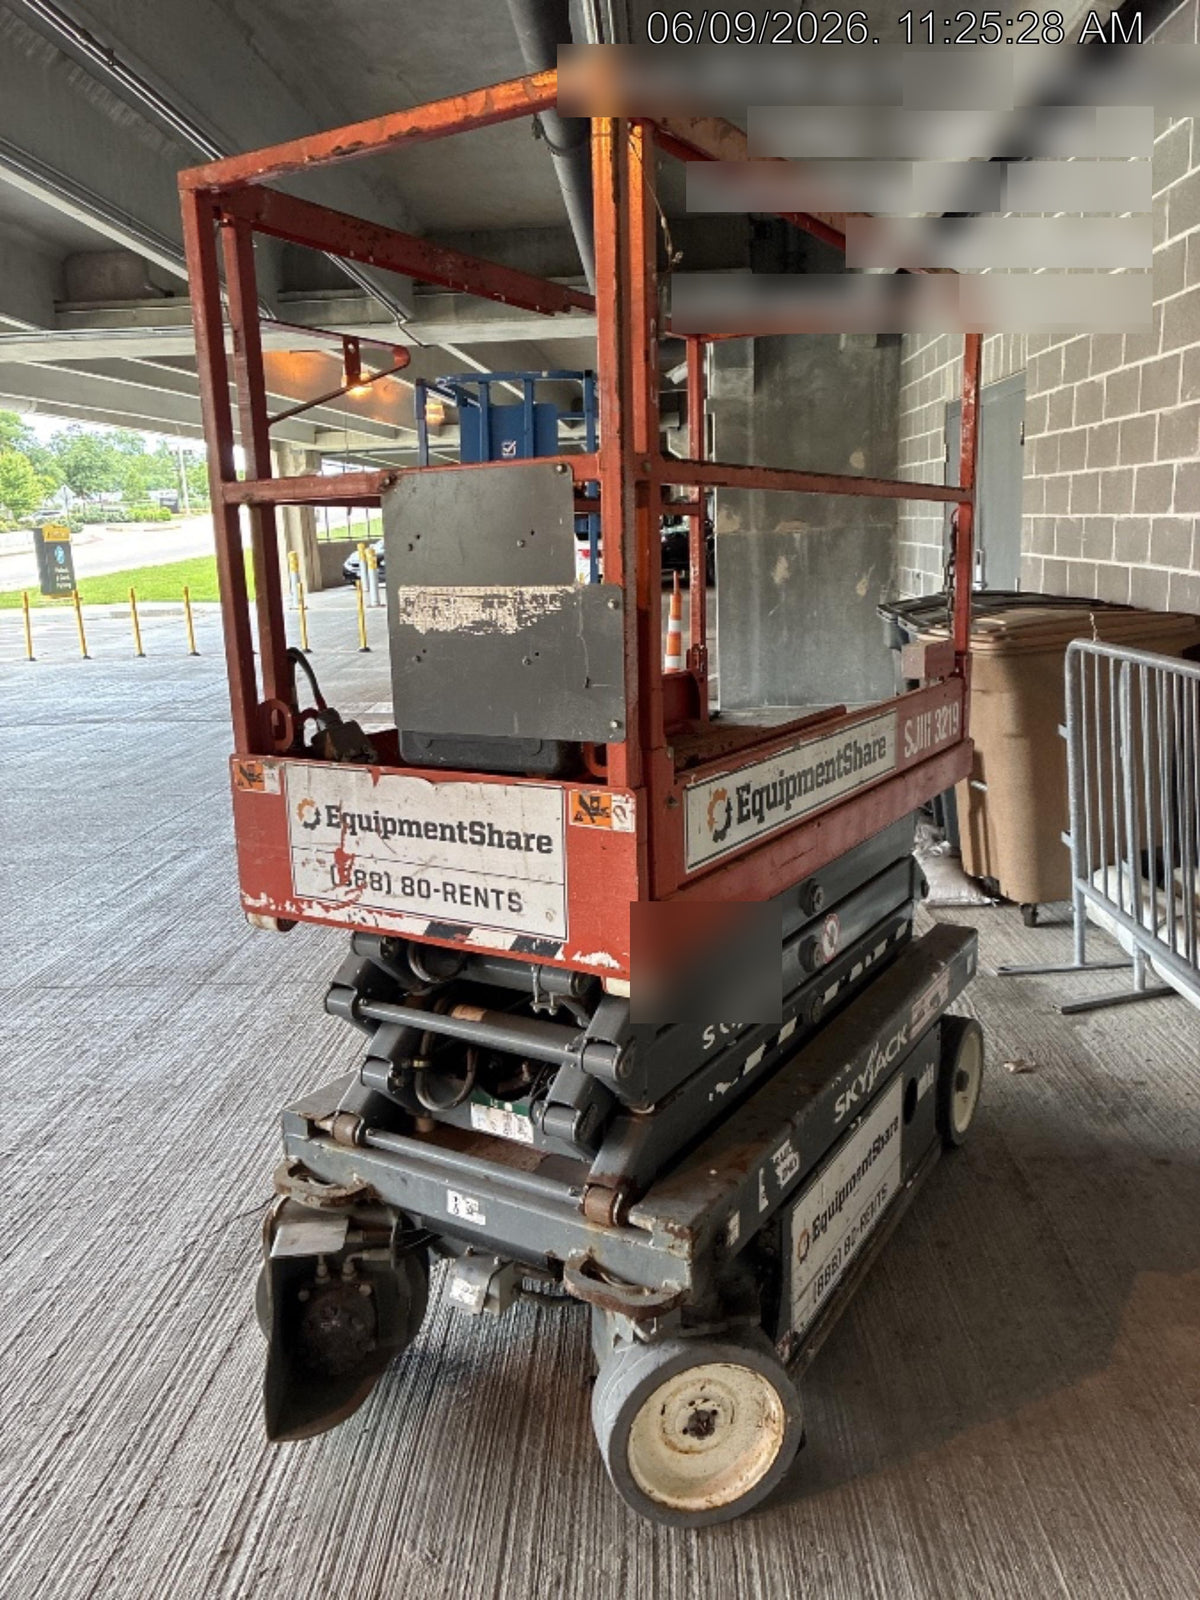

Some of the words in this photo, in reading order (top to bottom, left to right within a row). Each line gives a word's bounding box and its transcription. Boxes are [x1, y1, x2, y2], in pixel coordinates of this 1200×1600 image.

[935, 701, 959, 744] 3219
[736, 735, 887, 825] EquipmentShare
[325, 804, 553, 854] EquipmentShare
[401, 876, 524, 913] 80-RENTS
[834, 1023, 908, 1124] SKYJACK
[812, 1115, 899, 1244] EquipmentShare
